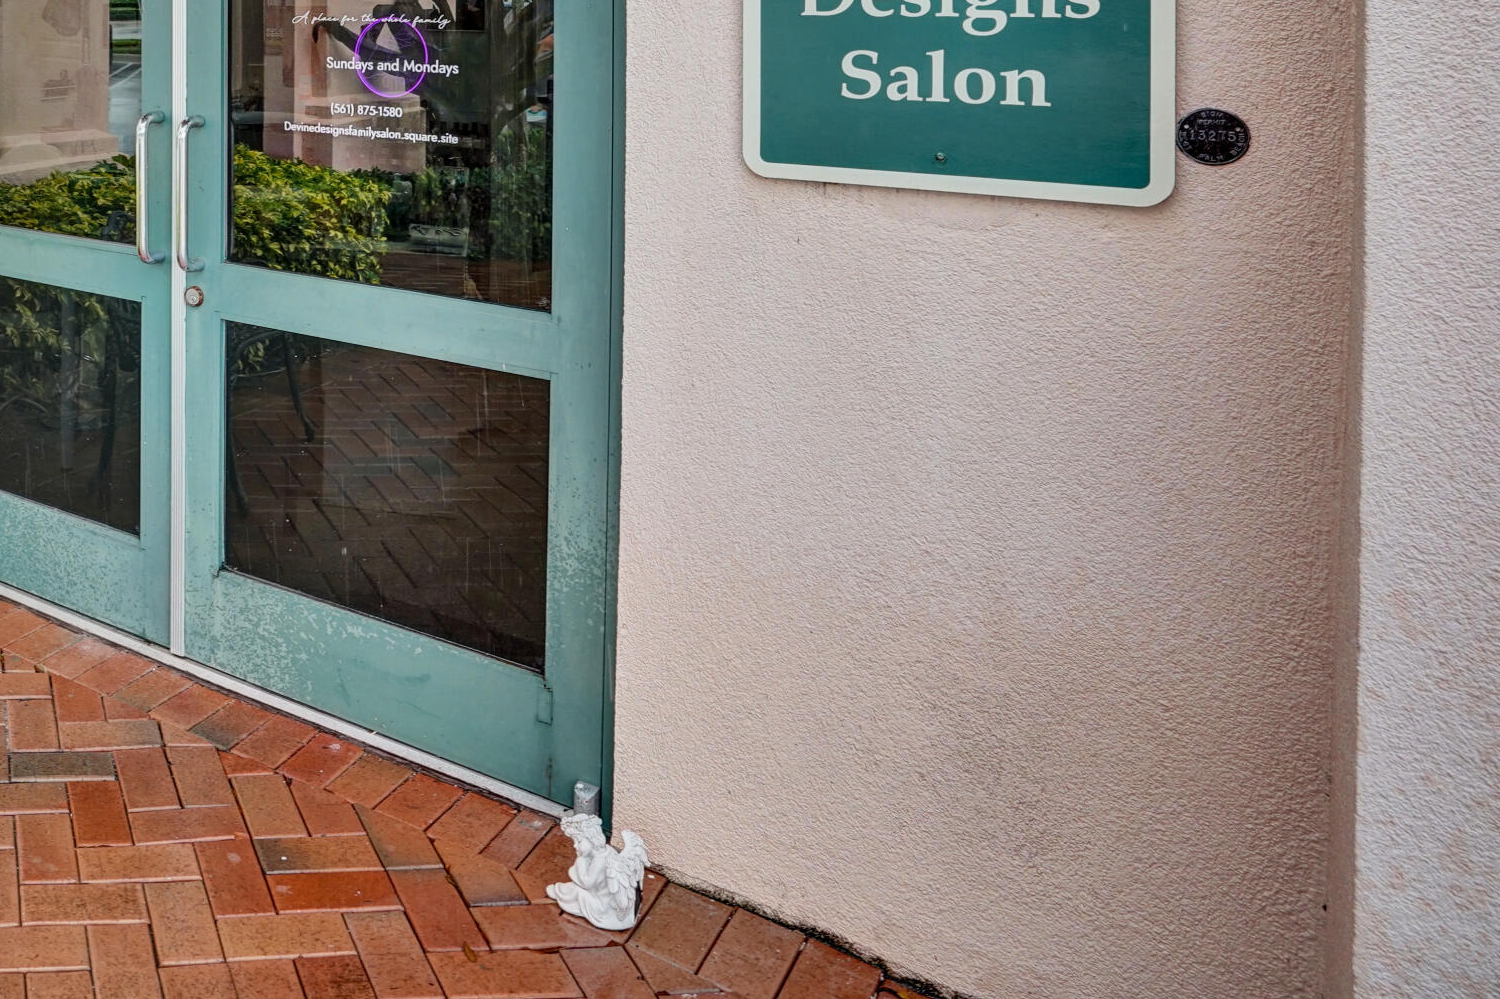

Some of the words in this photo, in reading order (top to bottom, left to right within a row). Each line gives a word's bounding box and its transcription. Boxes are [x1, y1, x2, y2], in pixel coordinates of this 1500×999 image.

[291, 10, 311, 25] A
[411, 14, 451, 30] family
[326, 56, 374, 73] Sundays
[376, 58, 400, 72] and
[403, 60, 460, 76] Mondays
[840, 49, 1052, 107] Salon
[330, 102, 355, 117] (561)
[357, 104, 404, 118] 875-1580
[283, 120, 460, 144] Devinedesignsfamilysalon.square.site
[1189, 129, 1237, 142] 13275
